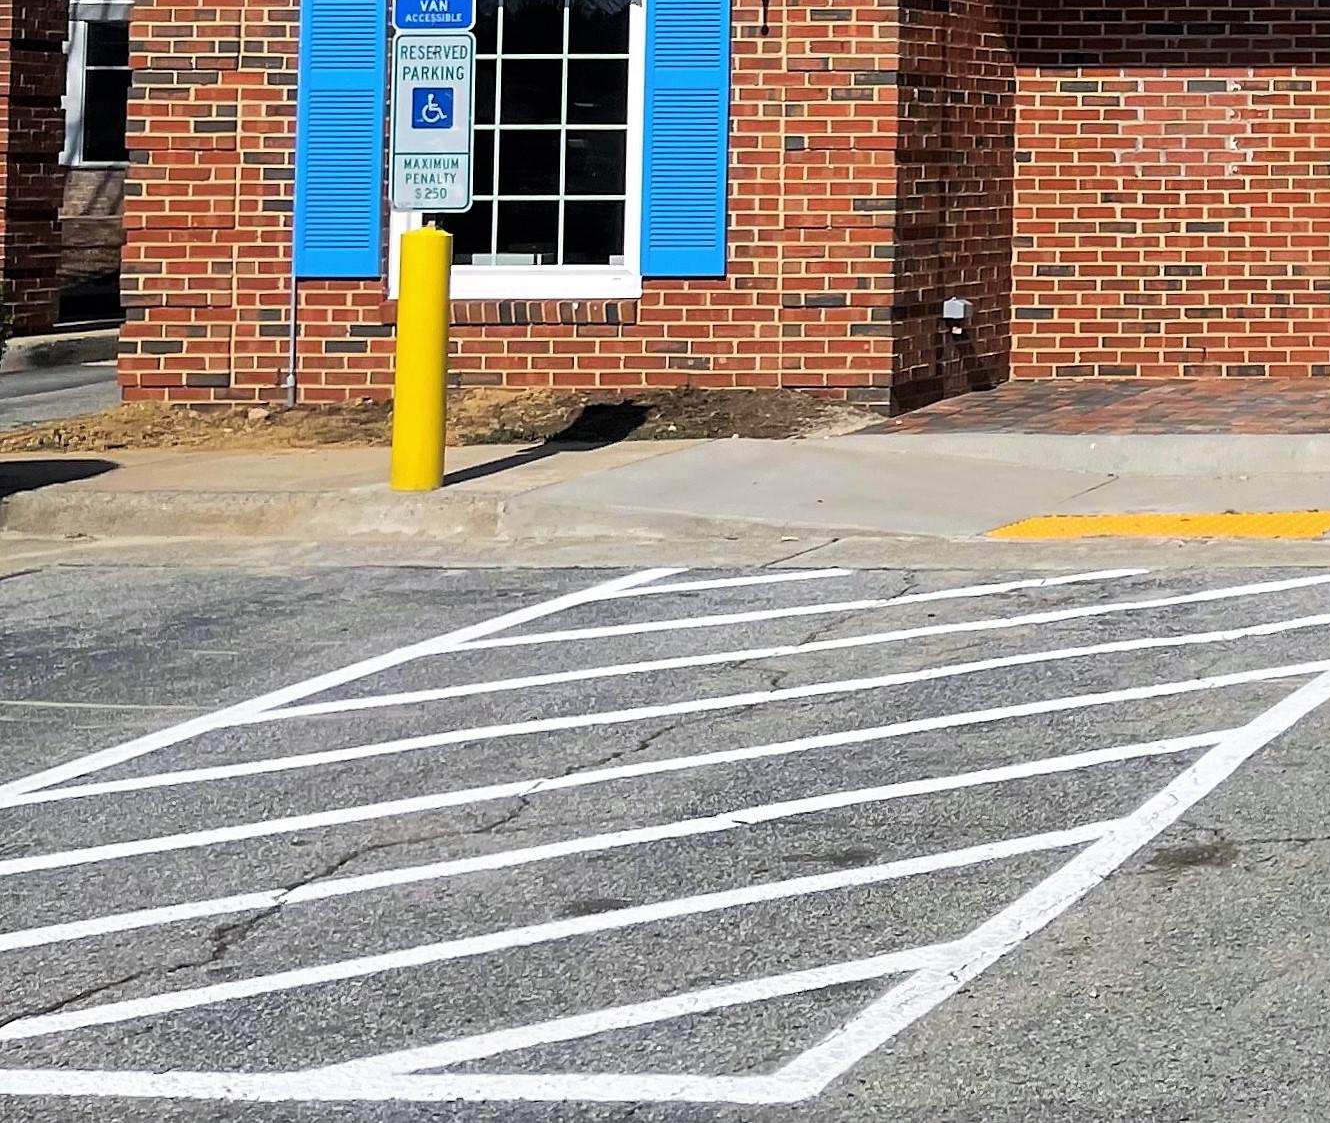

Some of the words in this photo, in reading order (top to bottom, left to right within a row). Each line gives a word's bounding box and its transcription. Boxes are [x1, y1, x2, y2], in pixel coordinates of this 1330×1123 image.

[420, 0, 448, 12] VAN
[404, 13, 463, 23] ACCESSIBLE
[400, 45, 468, 60] RESERVED
[402, 66, 465, 81] PARKING
[404, 158, 459, 170] MAXIMUM
[405, 172, 456, 184] PENALTY
